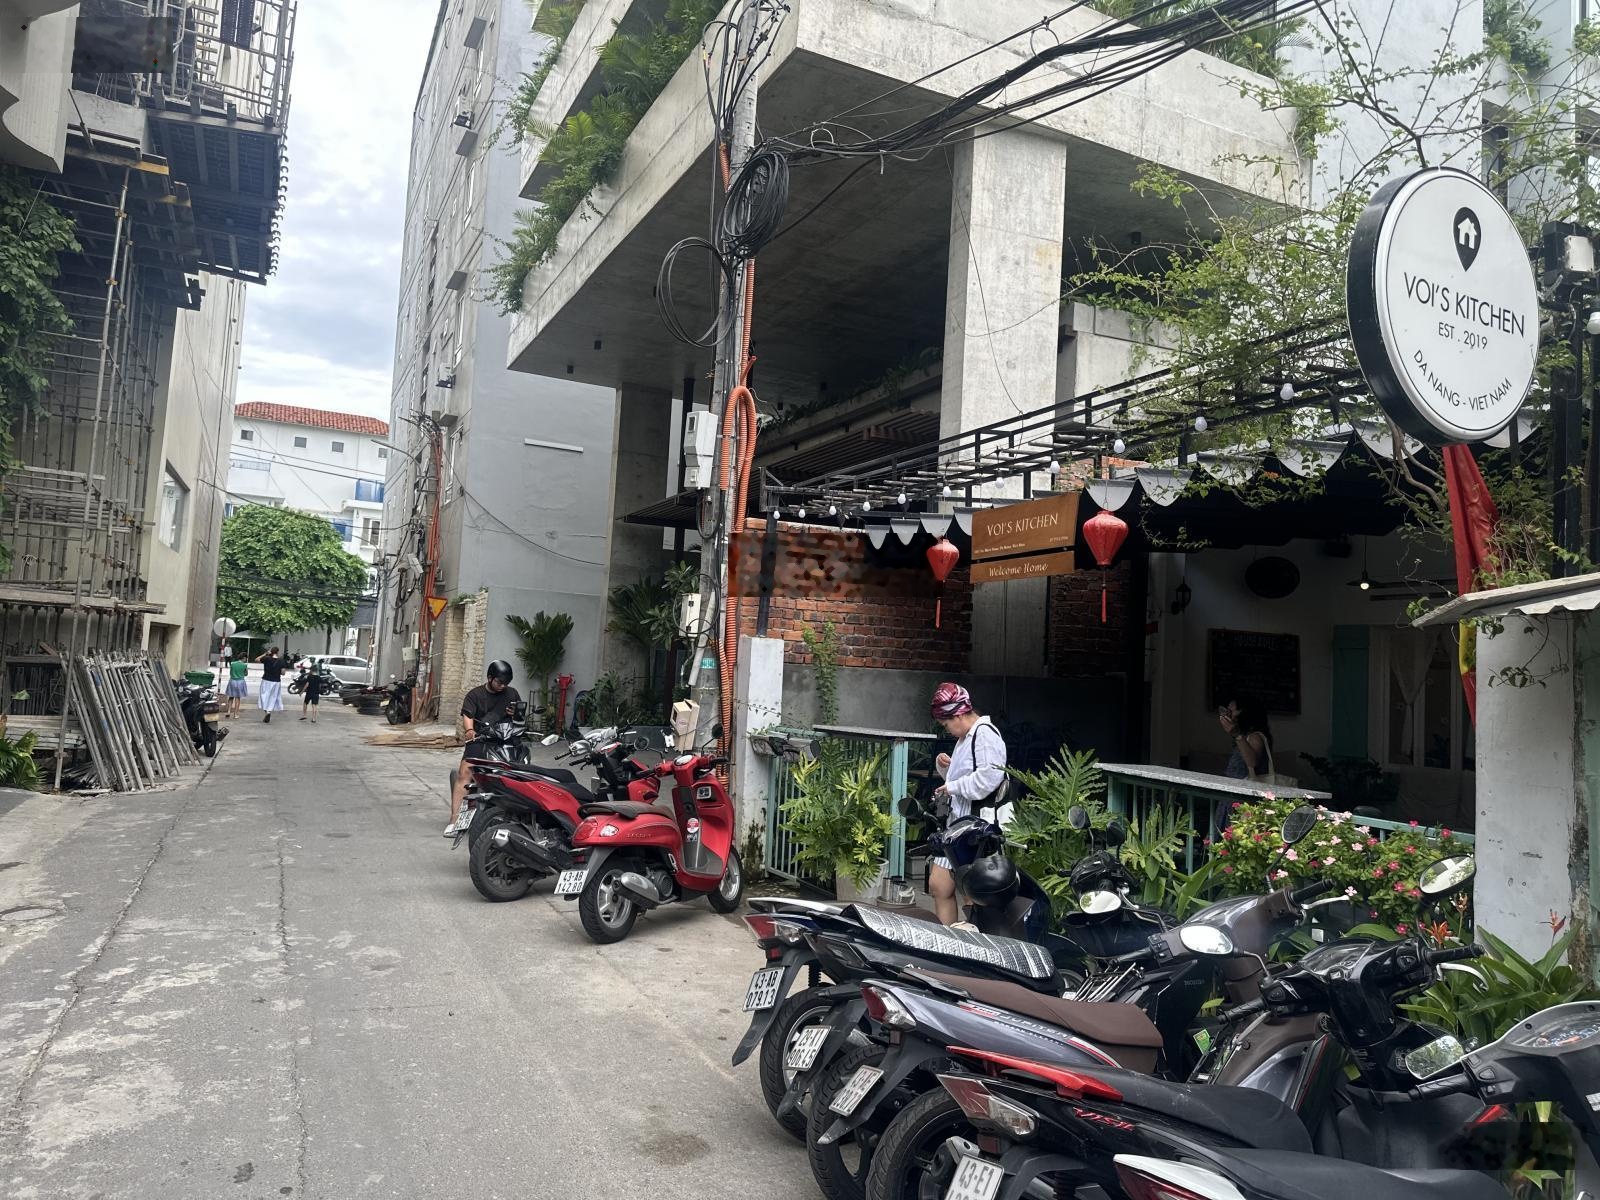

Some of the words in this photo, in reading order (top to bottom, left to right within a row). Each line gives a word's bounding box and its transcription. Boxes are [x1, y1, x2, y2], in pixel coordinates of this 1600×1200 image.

[1404, 272, 1450, 312] VOI'S
[1456, 292, 1525, 338] KITCHEN
[1463, 331, 1488, 350] 2019
[1413, 350, 1427, 377] DA
[1427, 374, 1460, 407] NANG
[1469, 394, 1489, 411] VIET
[1490, 376, 1512, 406] NAM
[987, 521, 1013, 536] VOI'S
[1015, 513, 1059, 533] KITCHEN
[989, 565, 1021, 577] Welcome
[1023, 562, 1048, 574] Home
[563, 871, 583, 882] 43-AB
[755, 971, 778, 989] 43-AB
[746, 988, 775, 1007] 079.13
[959, 1160, 995, 1196] 43-E1
